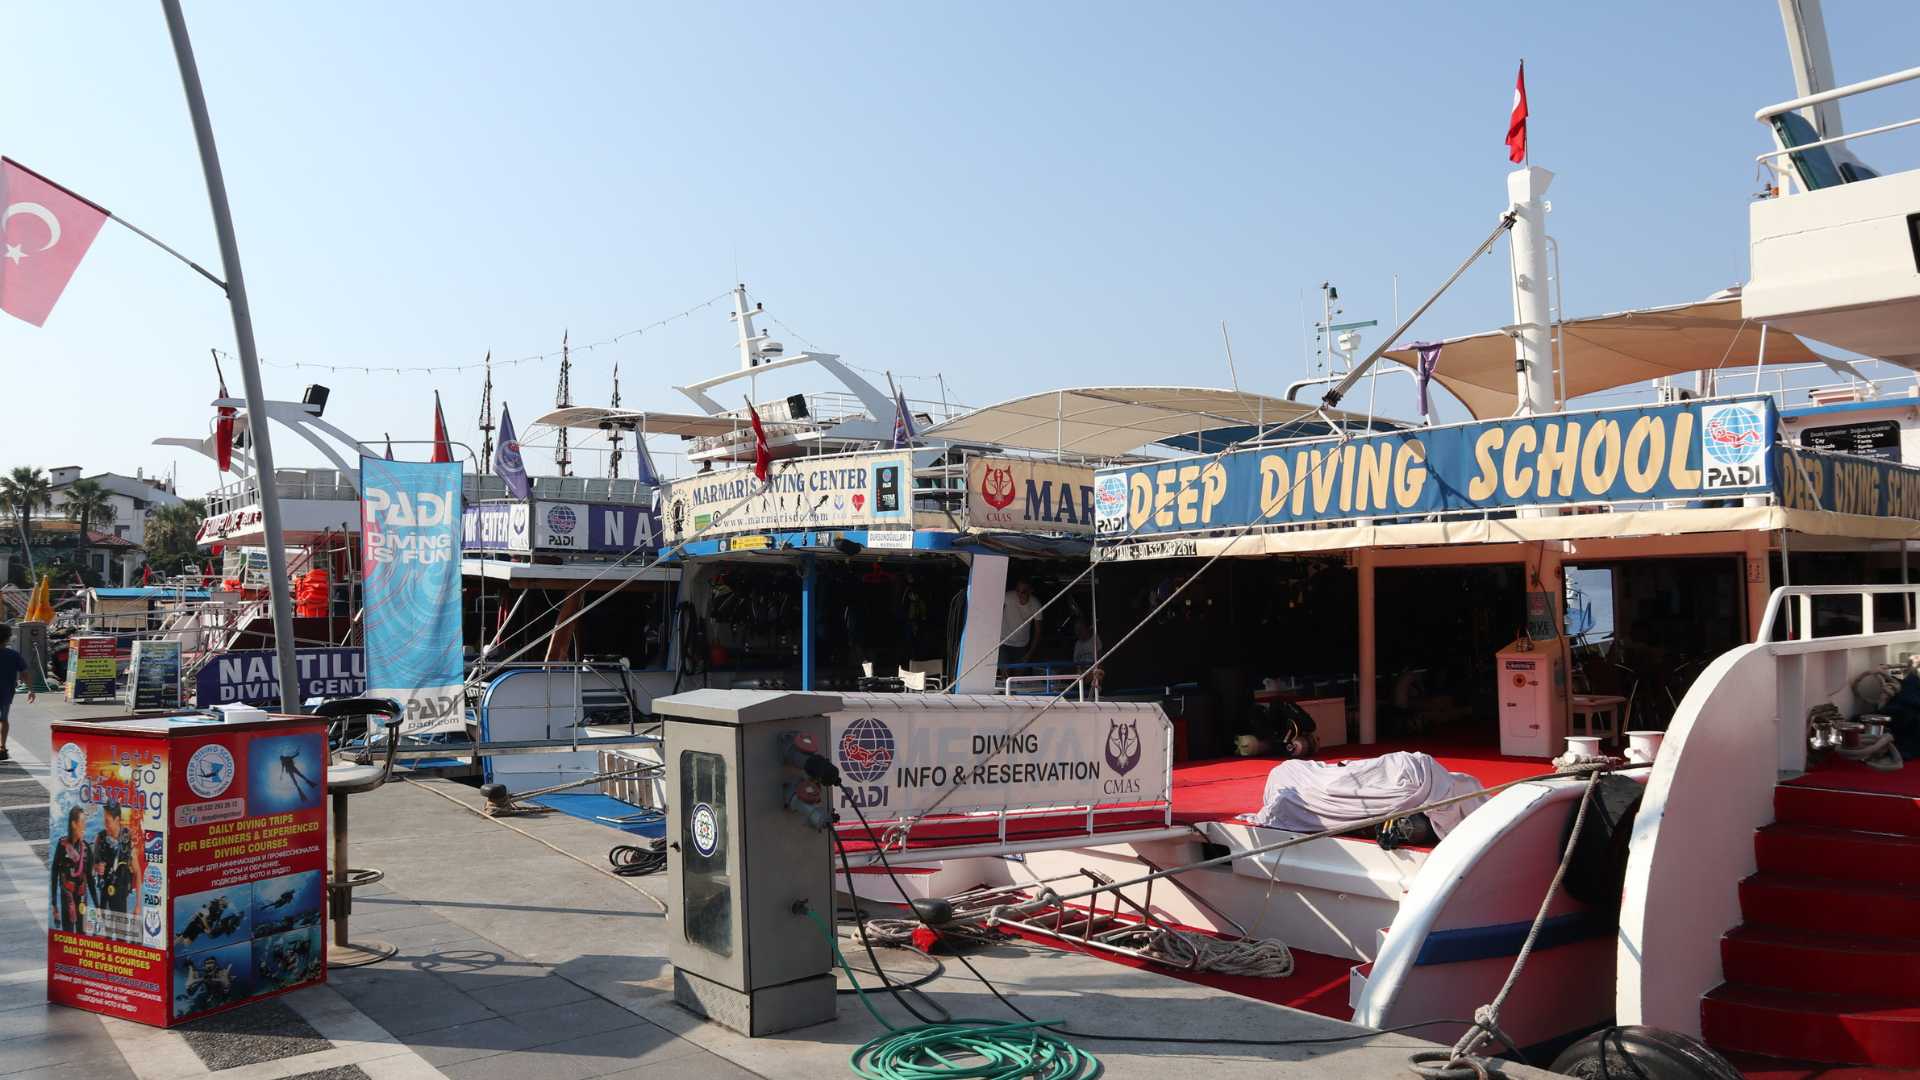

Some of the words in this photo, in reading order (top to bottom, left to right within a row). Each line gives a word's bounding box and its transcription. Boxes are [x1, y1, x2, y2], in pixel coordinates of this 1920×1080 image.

[809, 467, 867, 492] CENTER
[1128, 462, 1227, 530] DEEP
[1259, 438, 1428, 518] DIVING
[1469, 412, 1702, 500] SCHOOL
[1708, 464, 1760, 487] PADI
[366, 487, 452, 528] PADI
[986, 513, 1012, 522] CMAS
[481, 511, 508, 543] CENTER
[1097, 516, 1126, 533] PADI
[367, 531, 450, 549] DIVING
[549, 535, 574, 546] PADI
[367, 546, 393, 563] IS
[402, 548, 450, 564] FUN
[407, 695, 459, 720] PADI
[408, 718, 459, 730] padi.com
[971, 733, 1038, 755] DIVING
[132, 764, 156, 788] go
[897, 765, 947, 788] INFO
[953, 763, 967, 785] &
[972, 761, 1100, 785] RESERVATION
[79, 776, 164, 820] diving
[841, 786, 889, 809] PADI
[1103, 779, 1141, 795] CMAS
[208, 823, 234, 836] DAILY
[237, 817, 267, 831] DIVING
[269, 814, 293, 826] TRIPS
[178, 841, 198, 852] FOR
[200, 831, 251, 849] BEGINNERS
[254, 830, 261, 840] &
[263, 822, 319, 840] EXPERIENCED
[214, 846, 246, 859] DIVING
[249, 838, 288, 853] COURSES
[144, 894, 162, 906] PADI
[54, 933, 77, 945] SCUBA
[79, 938, 104, 950] DIVING
[113, 944, 161, 961] SNORKELING
[63, 945, 83, 956] DAILY
[85, 950, 106, 961] TRIPS
[114, 955, 151, 970] COURSES
[79, 958, 94, 969] FOR
[95, 961, 134, 976] EVERYONE
